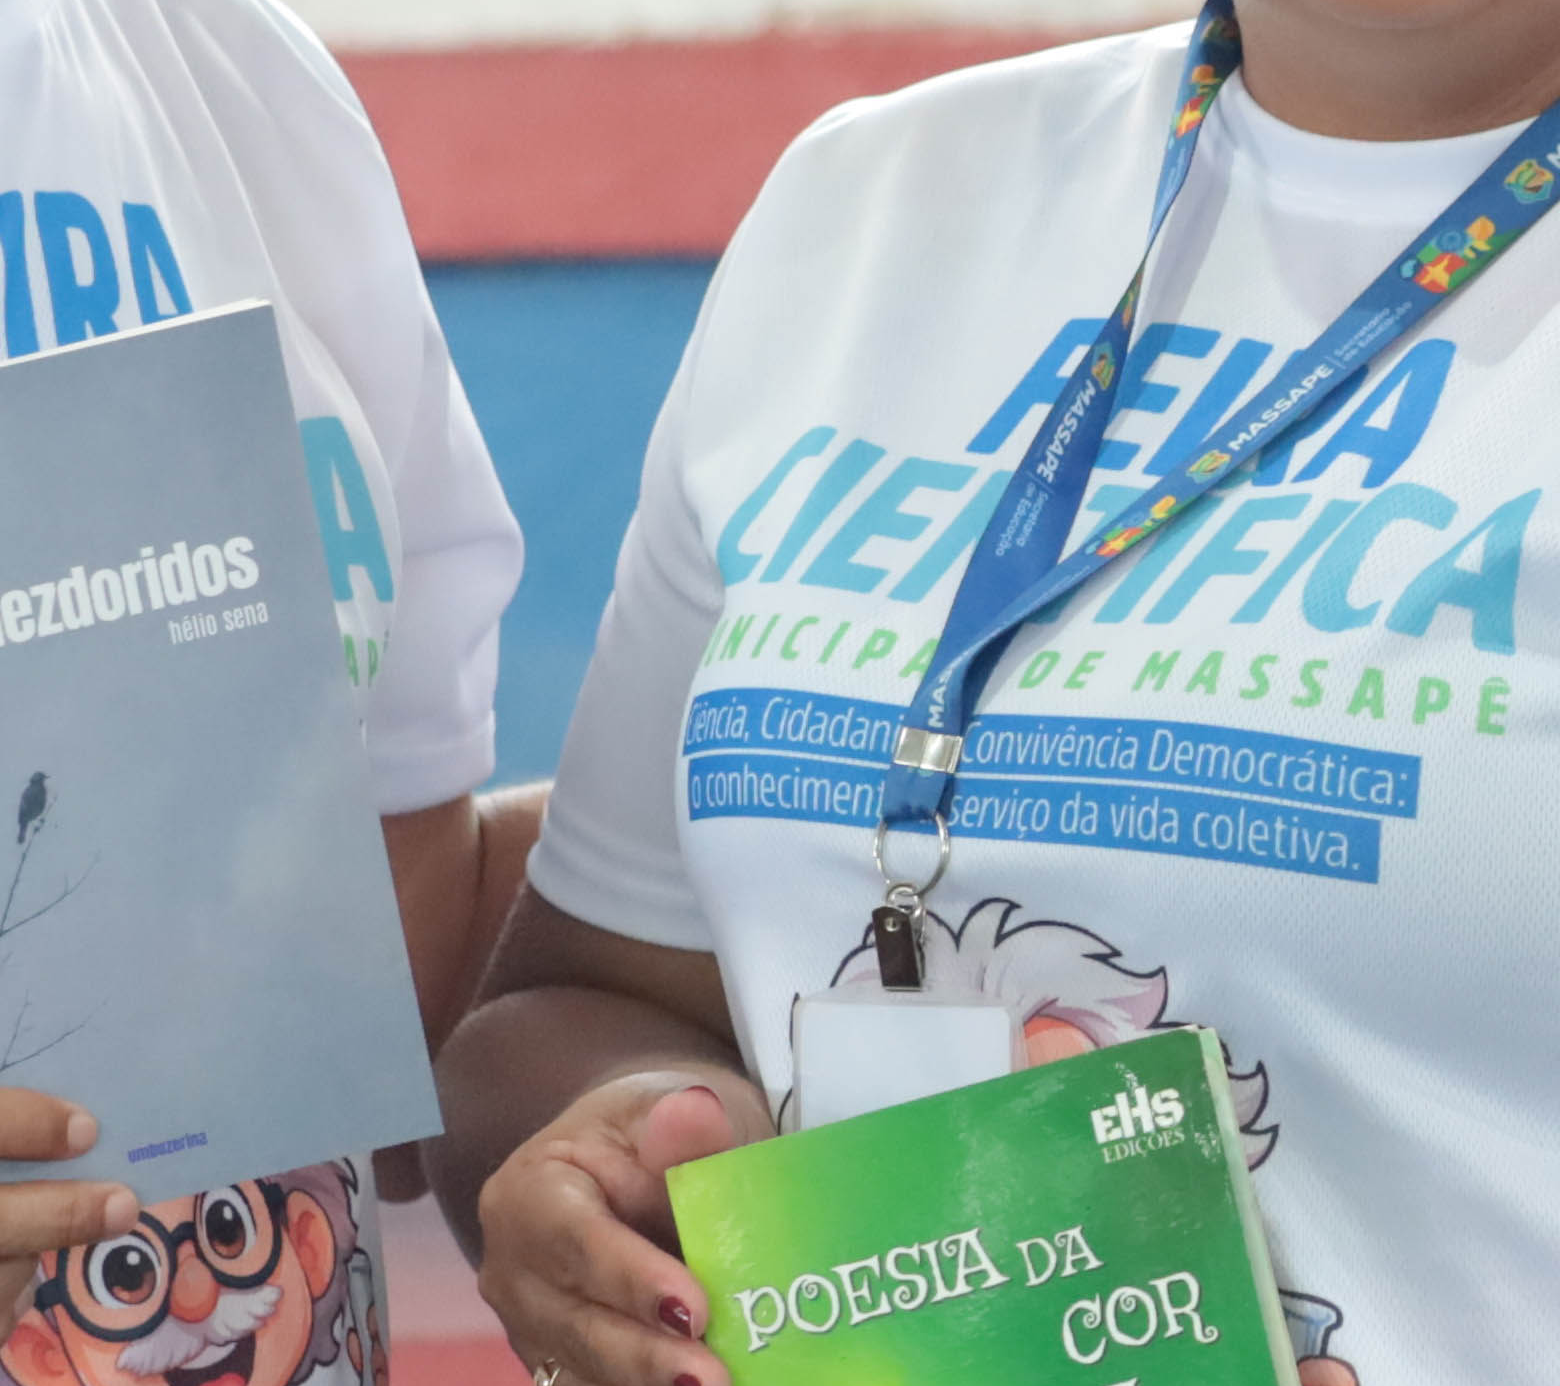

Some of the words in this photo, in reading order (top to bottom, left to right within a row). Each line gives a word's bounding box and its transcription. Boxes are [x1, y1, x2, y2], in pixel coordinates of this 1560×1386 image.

[167, 613, 218, 646] hélio
[222, 602, 270, 633] sena
[1017, 649, 1107, 690] DE
[1133, 649, 1512, 736] MASSAPÊ
[759, 695, 905, 755] Cidadani
[960, 720, 1138, 772] Convivência
[1147, 728, 1409, 808] Democrática:
[704, 766, 885, 820] conheciment
[949, 786, 1049, 841] serviço
[1059, 794, 1099, 837] da
[1109, 796, 1179, 845] vida
[1191, 805, 1361, 871] coletiva.
[1090, 1084, 1186, 1145] EHS
[733, 1226, 1011, 1354] POESIA
[1015, 1224, 1105, 1288] DA
[1061, 1270, 1220, 1366] COR
